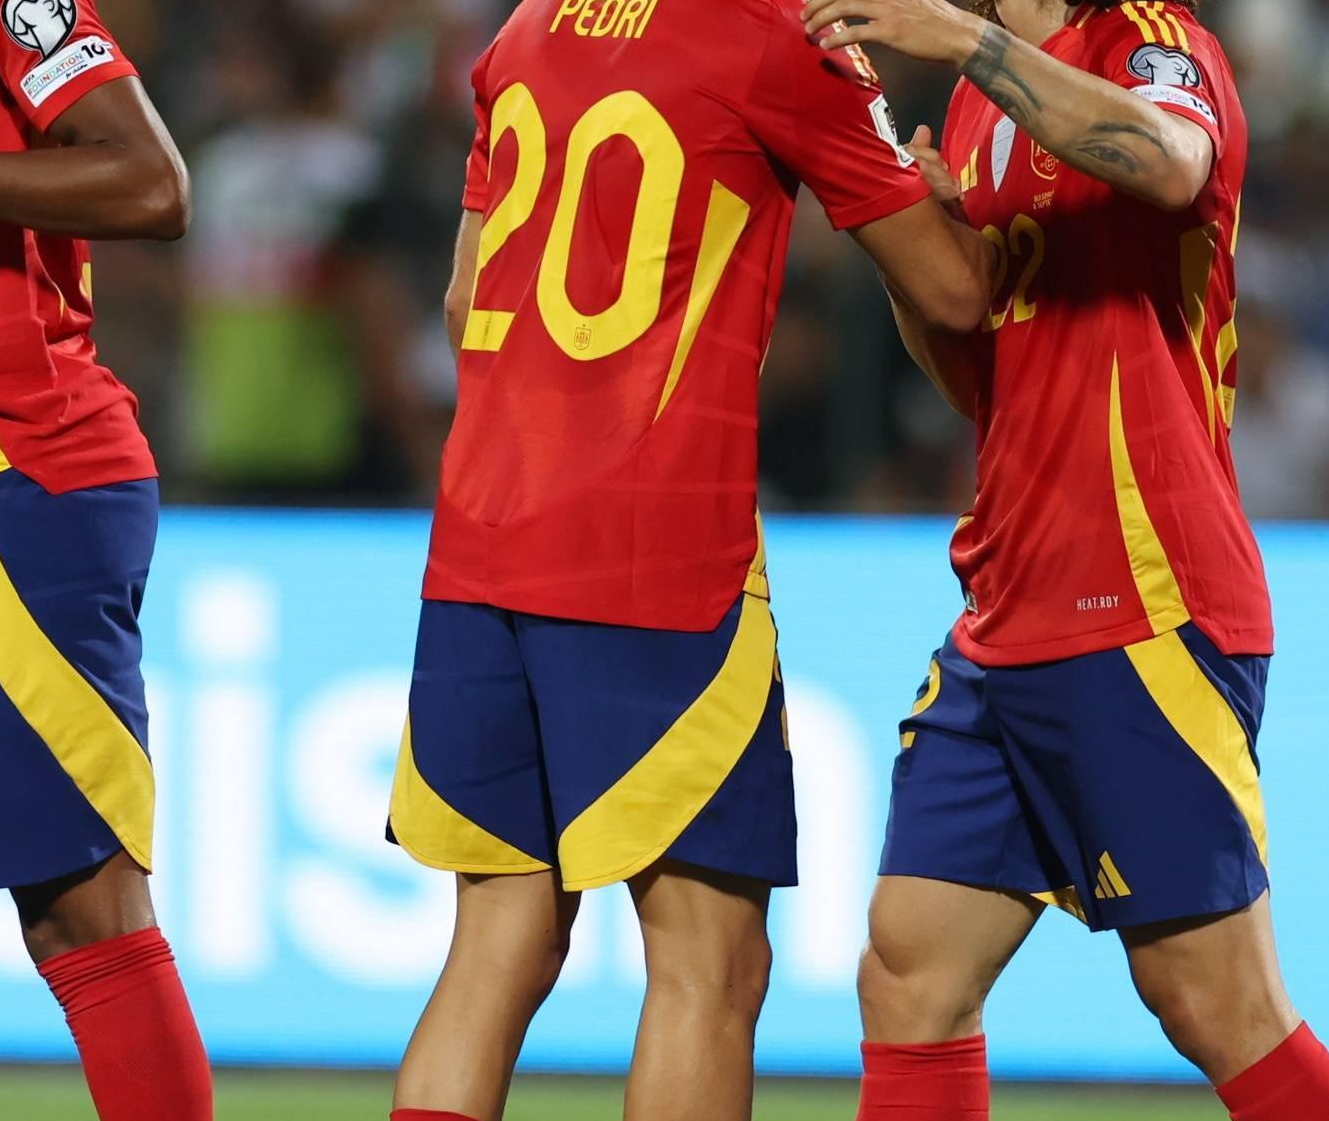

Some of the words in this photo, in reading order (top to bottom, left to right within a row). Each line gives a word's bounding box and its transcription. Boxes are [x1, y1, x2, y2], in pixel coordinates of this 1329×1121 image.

[27, 53, 83, 96] FOUNDATION
[461, 81, 685, 361] 20
[1076, 595, 1119, 611] HEAT.RDY
